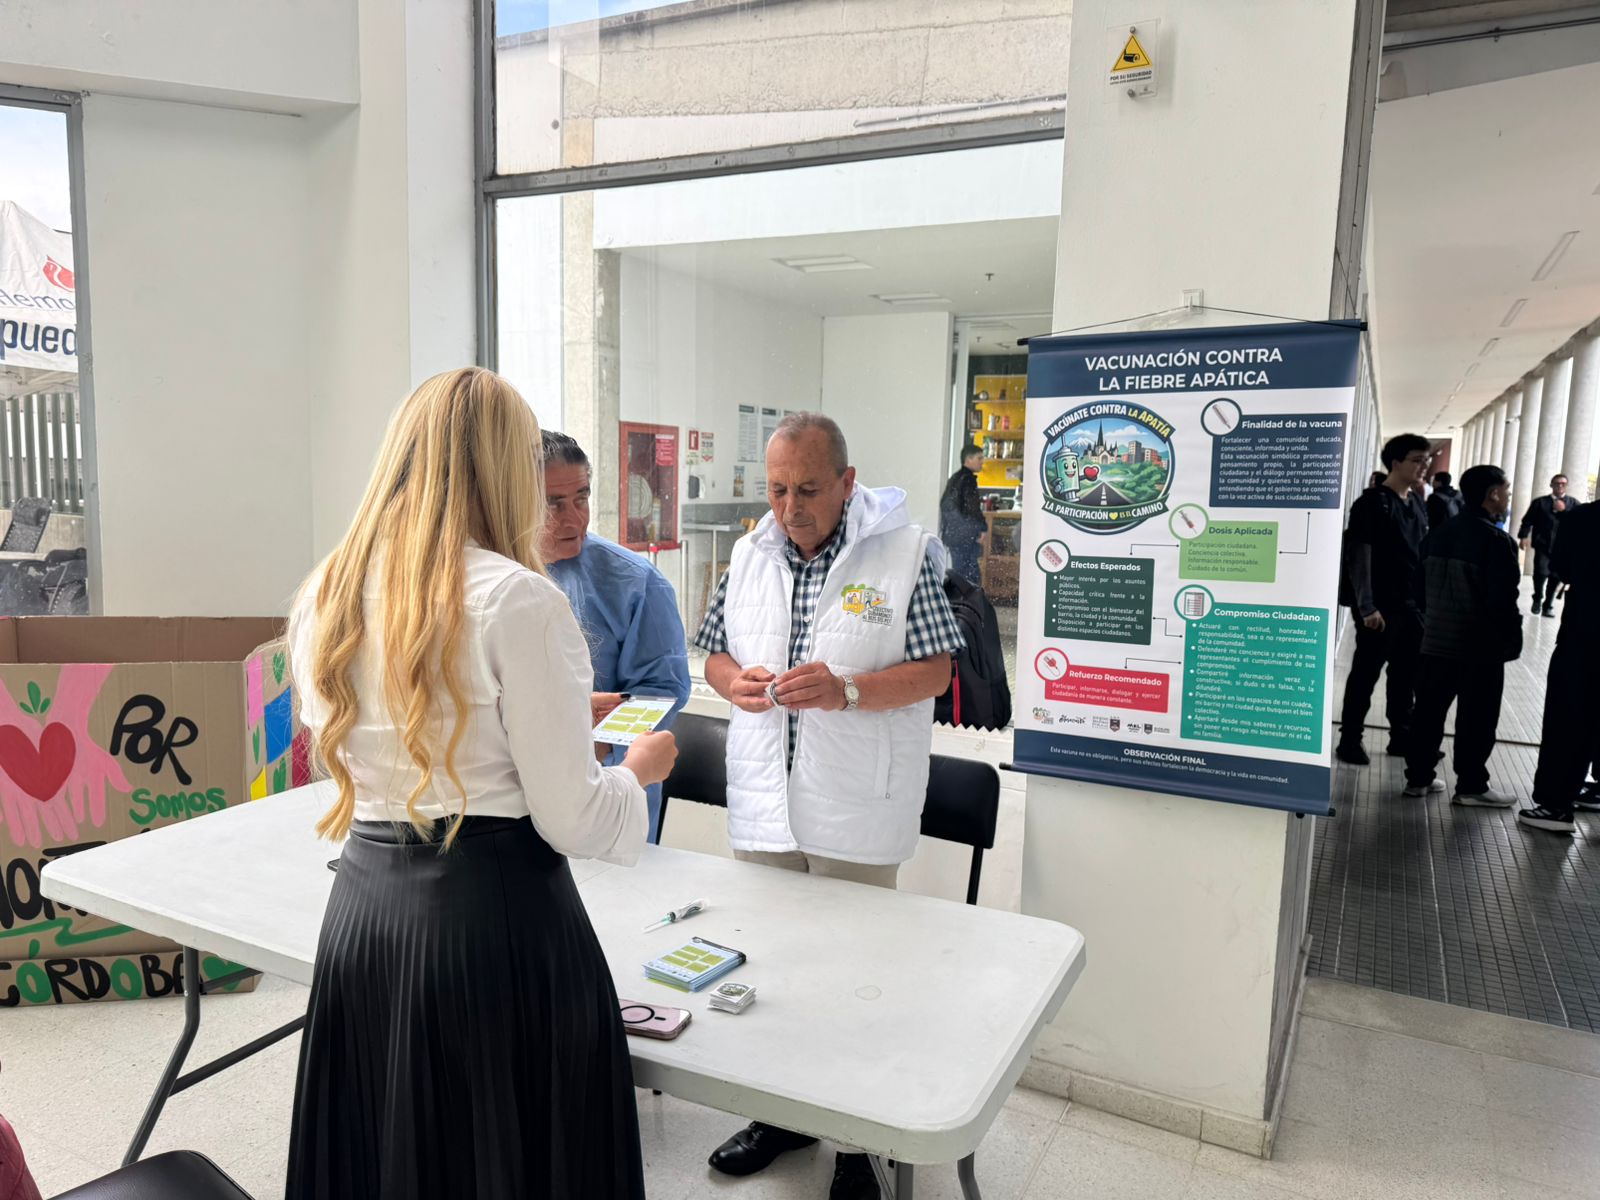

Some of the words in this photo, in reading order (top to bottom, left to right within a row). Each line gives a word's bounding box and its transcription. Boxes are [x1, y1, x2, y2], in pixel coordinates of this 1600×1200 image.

[1085, 349, 1200, 371] VACUNACIÓN
[1205, 348, 1283, 365] CONTRA
[1099, 378, 1120, 391] LA
[1125, 374, 1185, 390] FIEBRE
[1190, 368, 1269, 387] APÁTICA
[1048, 409, 1089, 436] VACÚNATE
[1090, 404, 1126, 415] CONTRA
[1128, 408, 1138, 418] LA
[1138, 411, 1170, 437] APATÍA
[1299, 420, 1307, 428] la
[1045, 501, 1054, 509] LA
[1055, 504, 1108, 520] PARTICIPACIÓN
[1132, 502, 1163, 516] CAMINO
[1234, 528, 1272, 536] Aplicada
[1071, 561, 1098, 569] Efectos
[1100, 562, 1141, 571] Esperados
[1058, 604, 1089, 612] Compromiso
[1214, 608, 1270, 618] Compromiso
[1272, 611, 1320, 622] Ciudadano
[1058, 618, 1085, 626] Disposición
[1199, 622, 1220, 630] Actuaré
[1199, 630, 1245, 639] responsabilidad,
[1276, 636, 1316, 644] representante
[1239, 648, 1269, 656] conciencia
[1277, 651, 1297, 659] exigiré
[1198, 654, 1240, 662] representantes
[1252, 658, 1292, 666] cumplimiento
[1069, 671, 1103, 680] Refuerzo
[1105, 674, 1162, 686] Recomendado
[1196, 669, 1228, 677] Compartiré
[1239, 673, 1274, 681] información
[1052, 683, 1077, 691] Participar,
[1112, 689, 1133, 697] dialogar
[1052, 690, 1080, 698] ciudadanía
[1196, 684, 1222, 692] difundiré.
[1195, 692, 1226, 700] Participaré
[1246, 696, 1271, 705] espacios
[1291, 701, 1312, 709] cuadra,
[1267, 706, 1291, 714] busquen
[1194, 715, 1218, 723] Aportaré
[1254, 720, 1276, 728] saberes
[1284, 725, 1312, 733] recursos,
[1260, 728, 1287, 738] bienestar
[1124, 748, 1181, 762] OBSERVACIÓN
[1183, 756, 1207, 766] FINAL
[1092, 752, 1119, 761] obligatoria,
[1143, 759, 1161, 767] efectos
[1162, 762, 1188, 770] fortalecen
[1195, 766, 1226, 775] democracia
[1258, 775, 1288, 783] comunidad.
